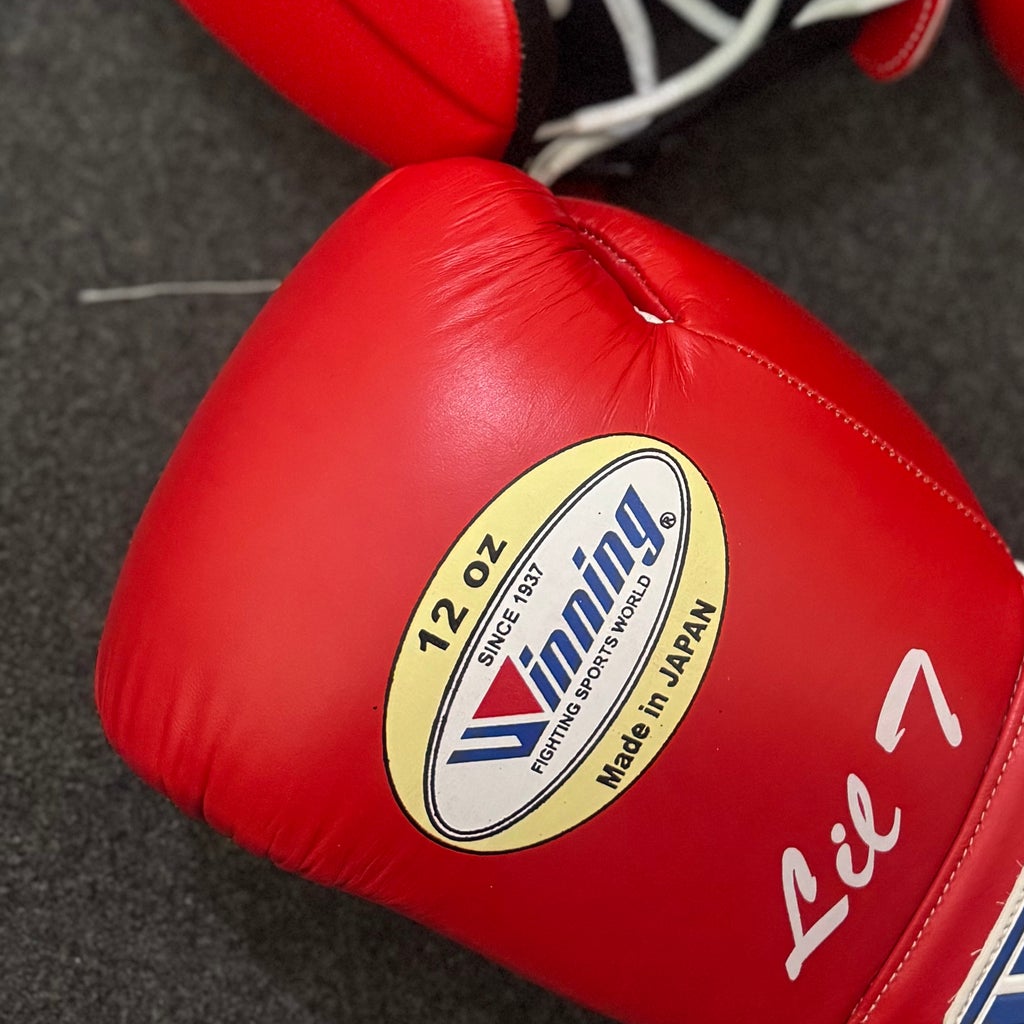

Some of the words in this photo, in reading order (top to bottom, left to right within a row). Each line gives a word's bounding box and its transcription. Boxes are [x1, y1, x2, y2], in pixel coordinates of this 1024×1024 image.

[417, 598, 469, 655] 12
[463, 533, 508, 588] oz
[446, 483, 666, 766] Winning
[477, 611, 520, 668] SINCE
[514, 562, 545, 605] 1937
[530, 702, 581, 775] FIGHTING
[575, 638, 618, 701] SPORTS
[614, 574, 651, 635] WORLD
[596, 724, 650, 790] Made
[638, 689, 668, 719] in
[661, 598, 717, 688] JAPAN
[782, 773, 901, 981] Lil
